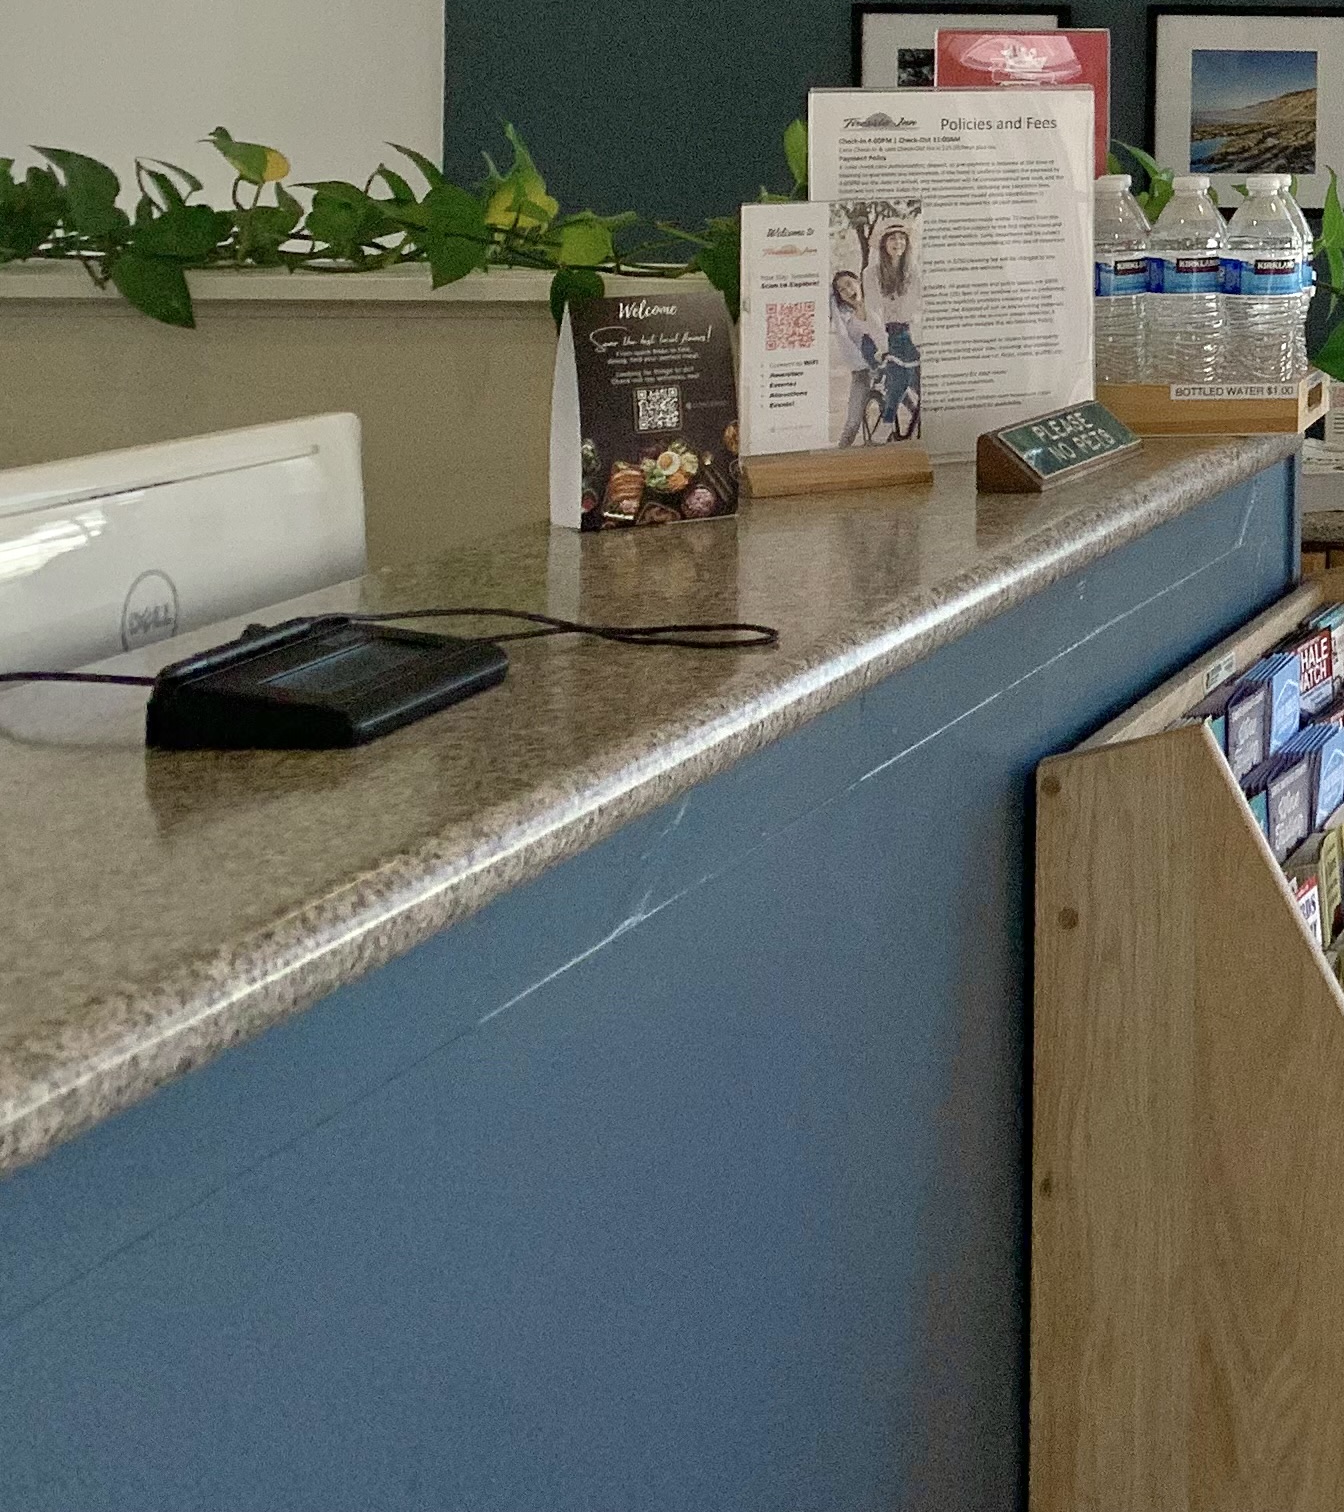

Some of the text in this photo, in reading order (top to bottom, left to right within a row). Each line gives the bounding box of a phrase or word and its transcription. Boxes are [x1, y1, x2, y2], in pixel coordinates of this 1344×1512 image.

[941, 116, 1058, 132] Policies and Fees
[618, 299, 678, 320] Welcome
[1175, 385, 1294, 397] BOTTLED WATER $1.00
[1031, 412, 1094, 442] PLEASE
[1048, 428, 1116, 463] NO PETS
[1300, 637, 1330, 674] HALE
